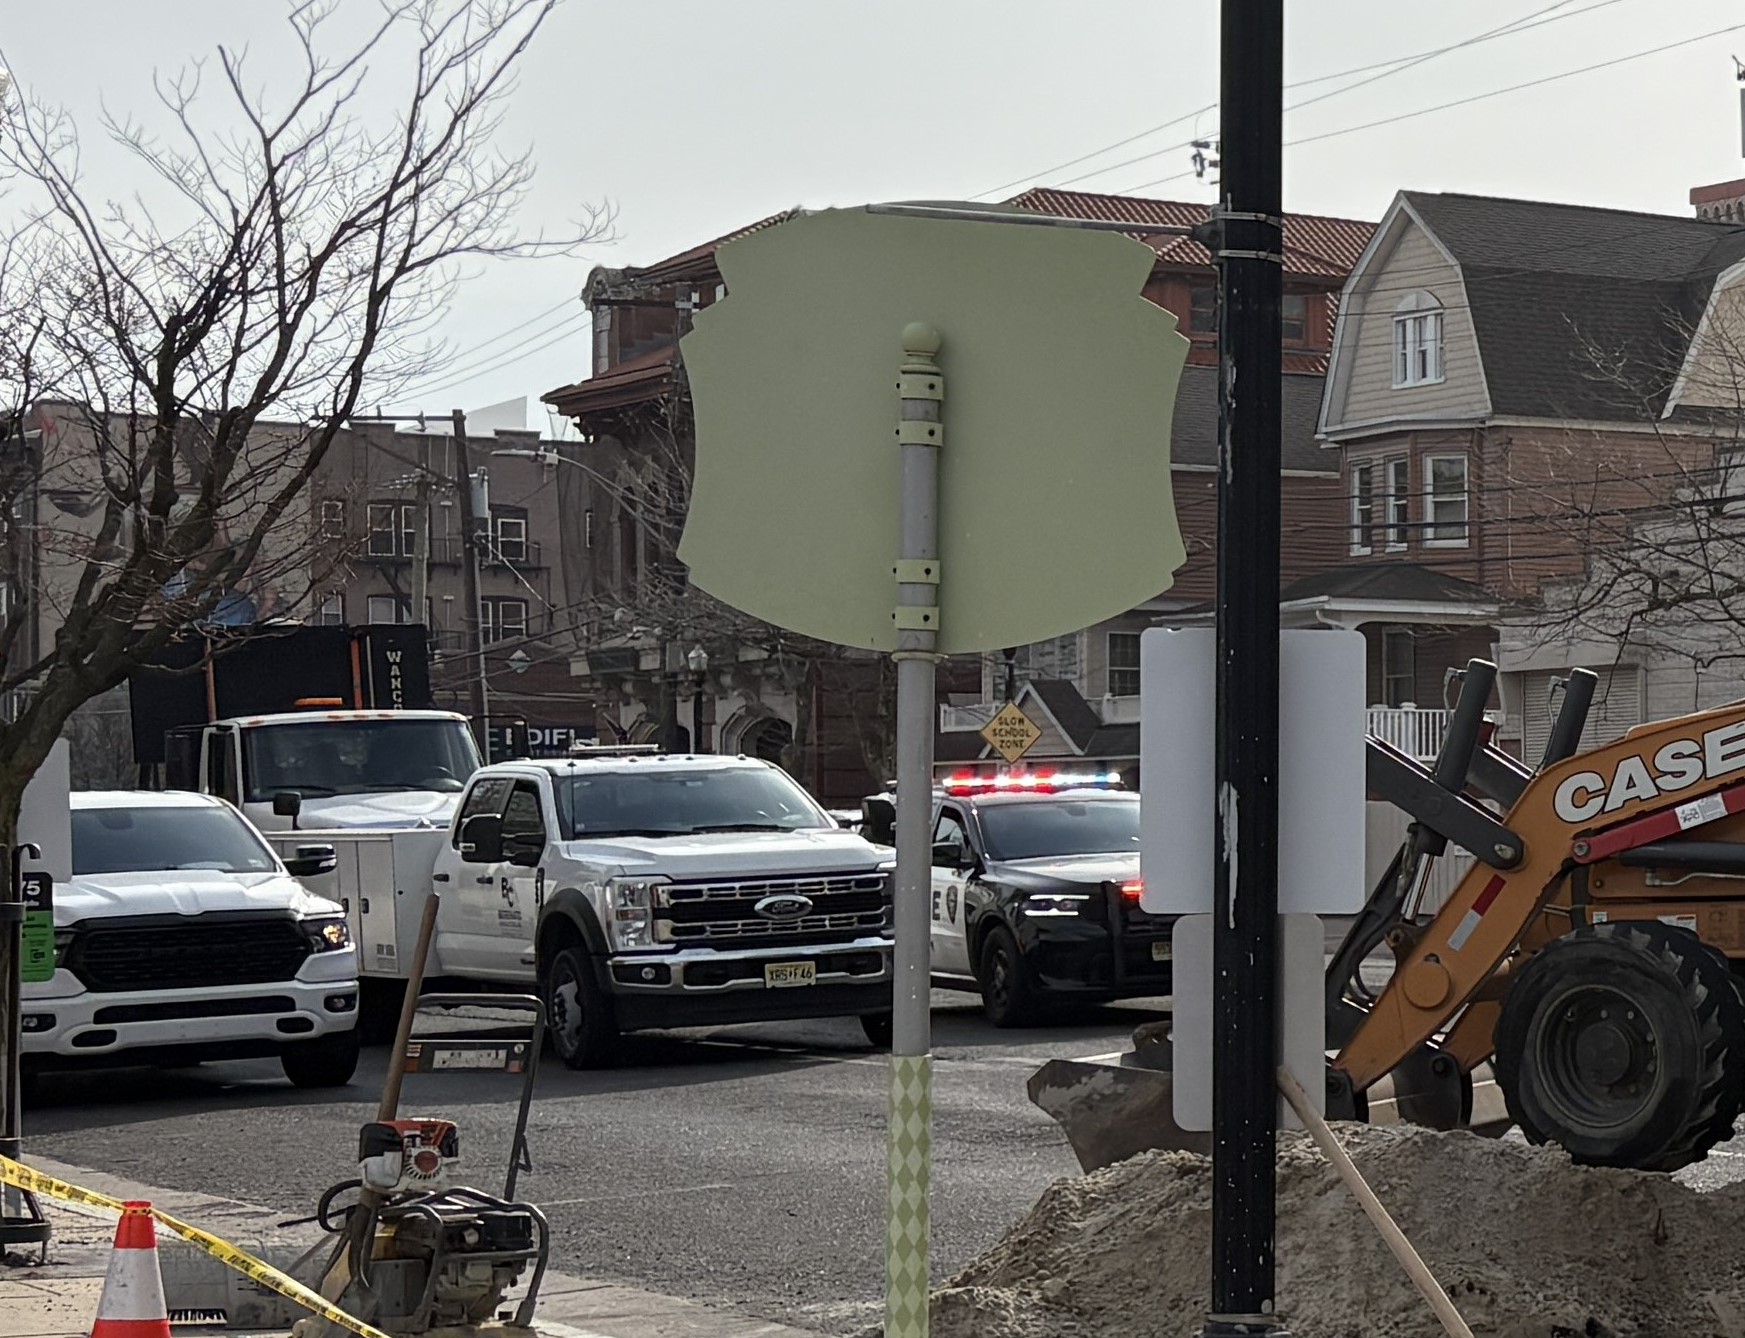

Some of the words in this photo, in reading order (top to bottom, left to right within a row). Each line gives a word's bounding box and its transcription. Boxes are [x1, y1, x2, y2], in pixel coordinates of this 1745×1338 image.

[998, 716, 1025, 727] SLOW
[992, 726, 1032, 738] SCHOOL
[999, 739, 1025, 749] ZONE
